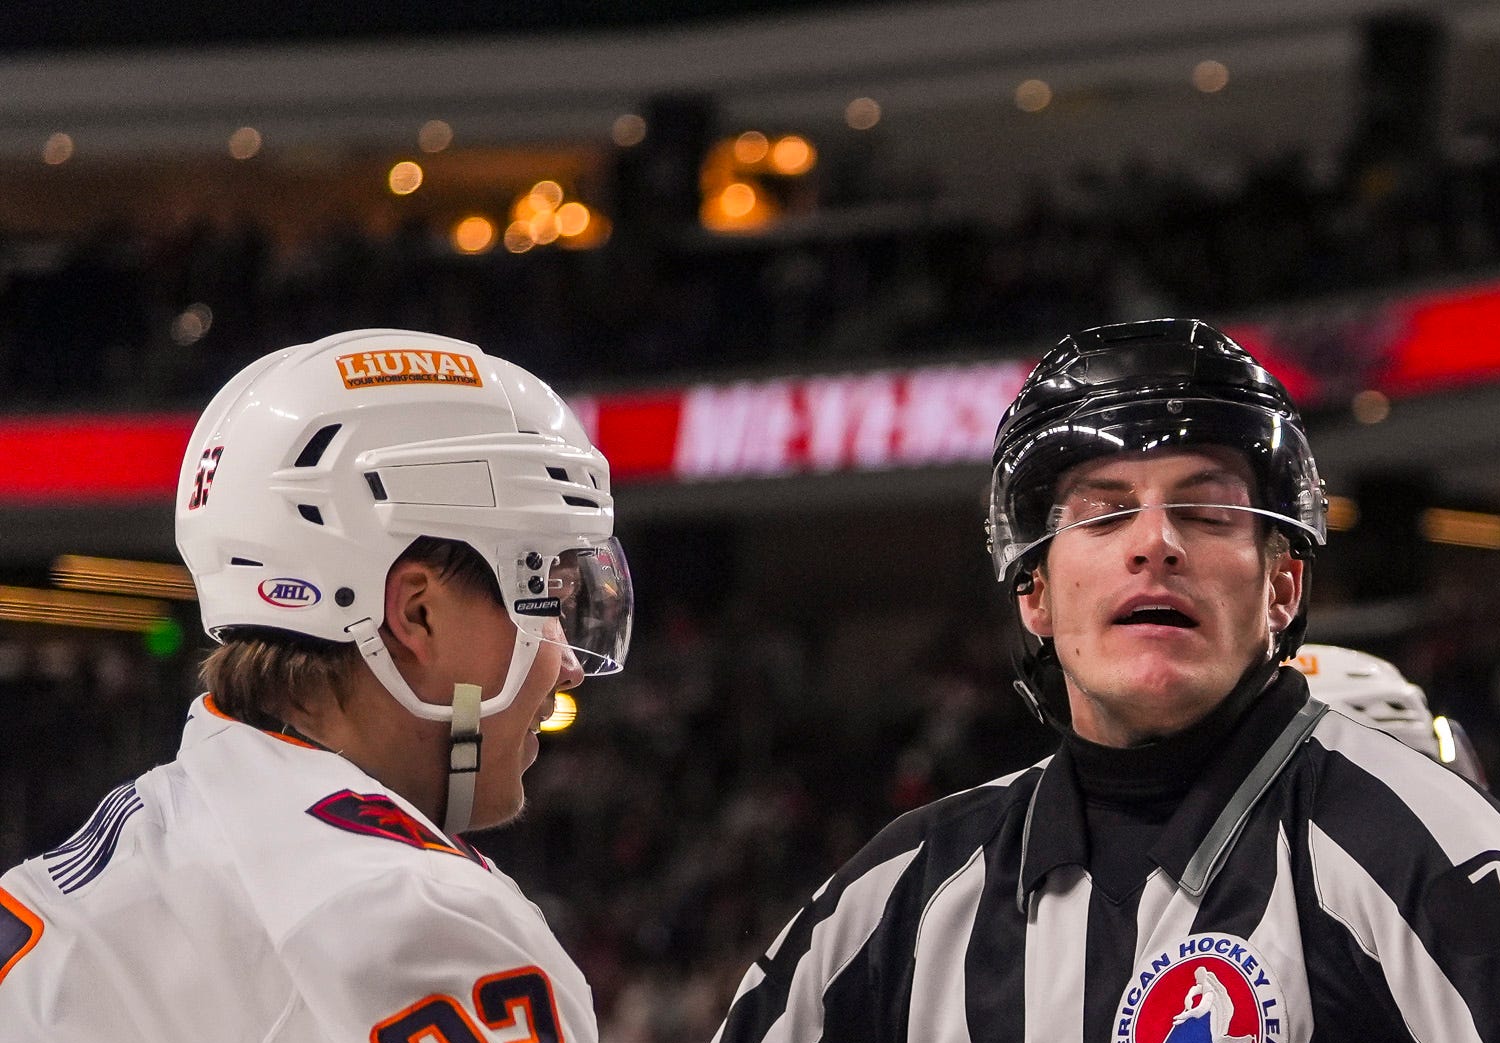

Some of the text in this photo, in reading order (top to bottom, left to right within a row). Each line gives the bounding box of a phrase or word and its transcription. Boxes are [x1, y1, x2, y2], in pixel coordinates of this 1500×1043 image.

[348, 376, 374, 387] YOUR
[375, 374, 432, 384] WORKFORCE
[268, 583, 310, 601] AHL
[517, 600, 558, 611] BAUER
[1179, 937, 1270, 988] HOCKEY
